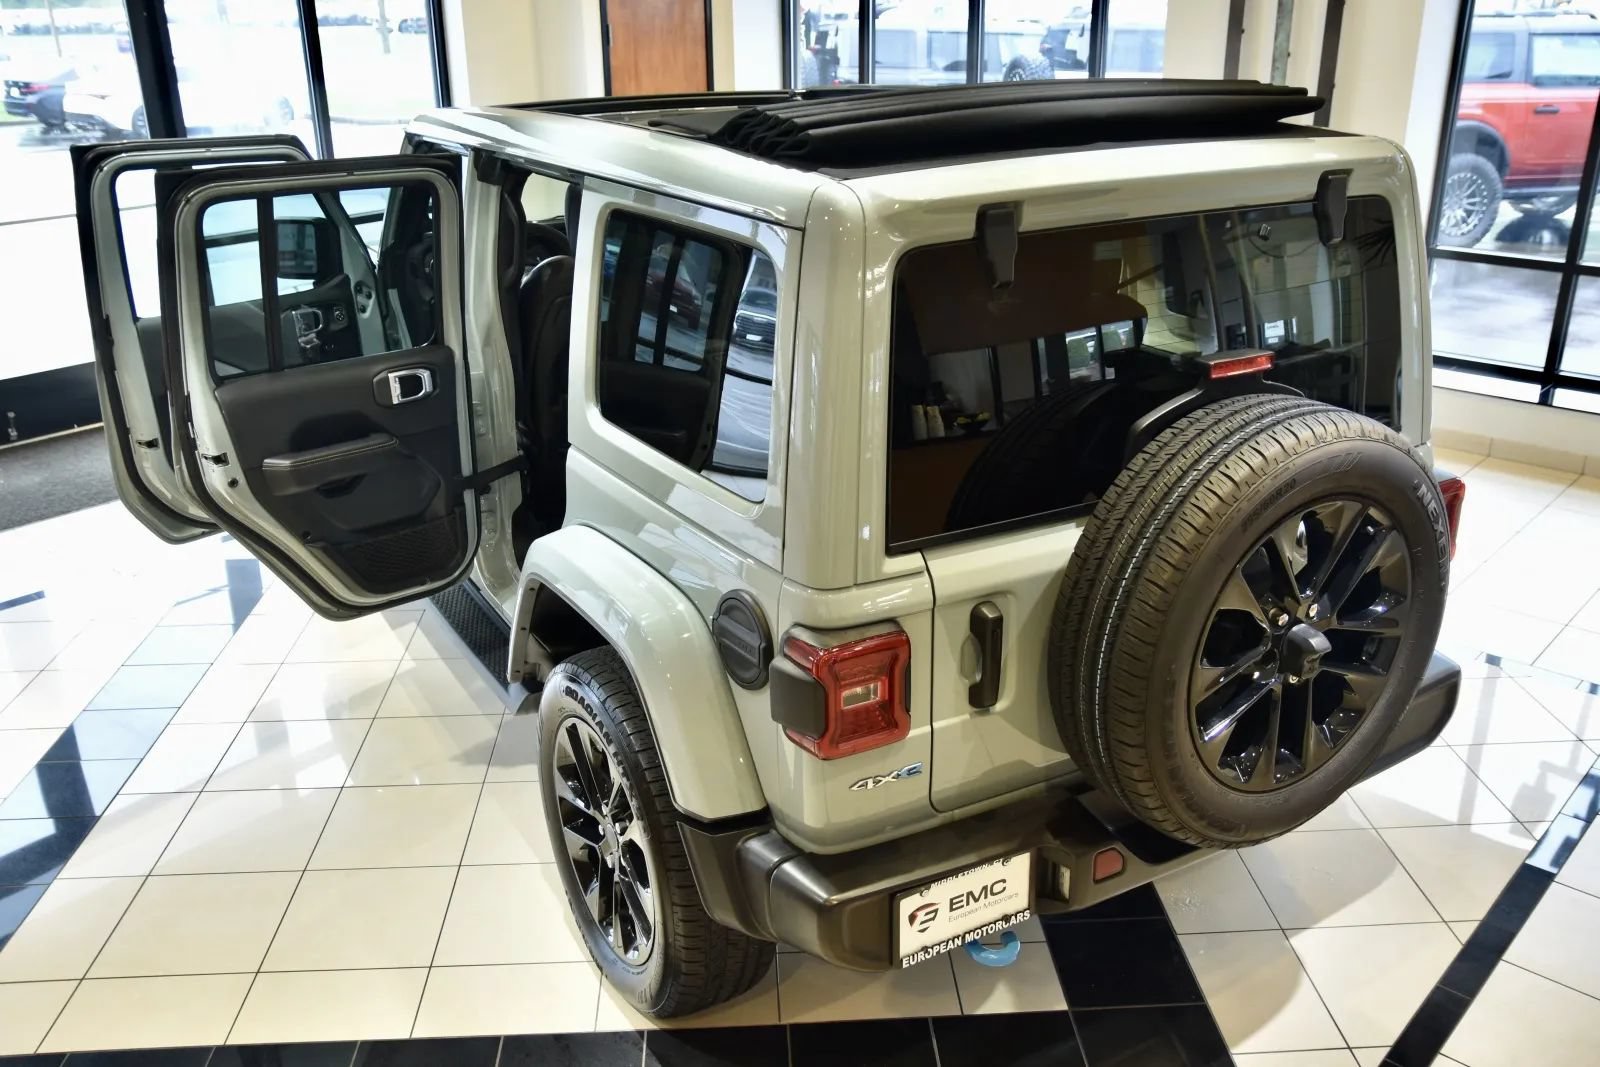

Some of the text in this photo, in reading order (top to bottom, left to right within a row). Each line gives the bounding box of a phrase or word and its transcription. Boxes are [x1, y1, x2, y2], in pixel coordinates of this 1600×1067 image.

[948, 892, 1019, 923] European Motorcars
[949, 879, 1007, 912] EMC
[902, 909, 1031, 969] EUROPEAN MOTORCARS
